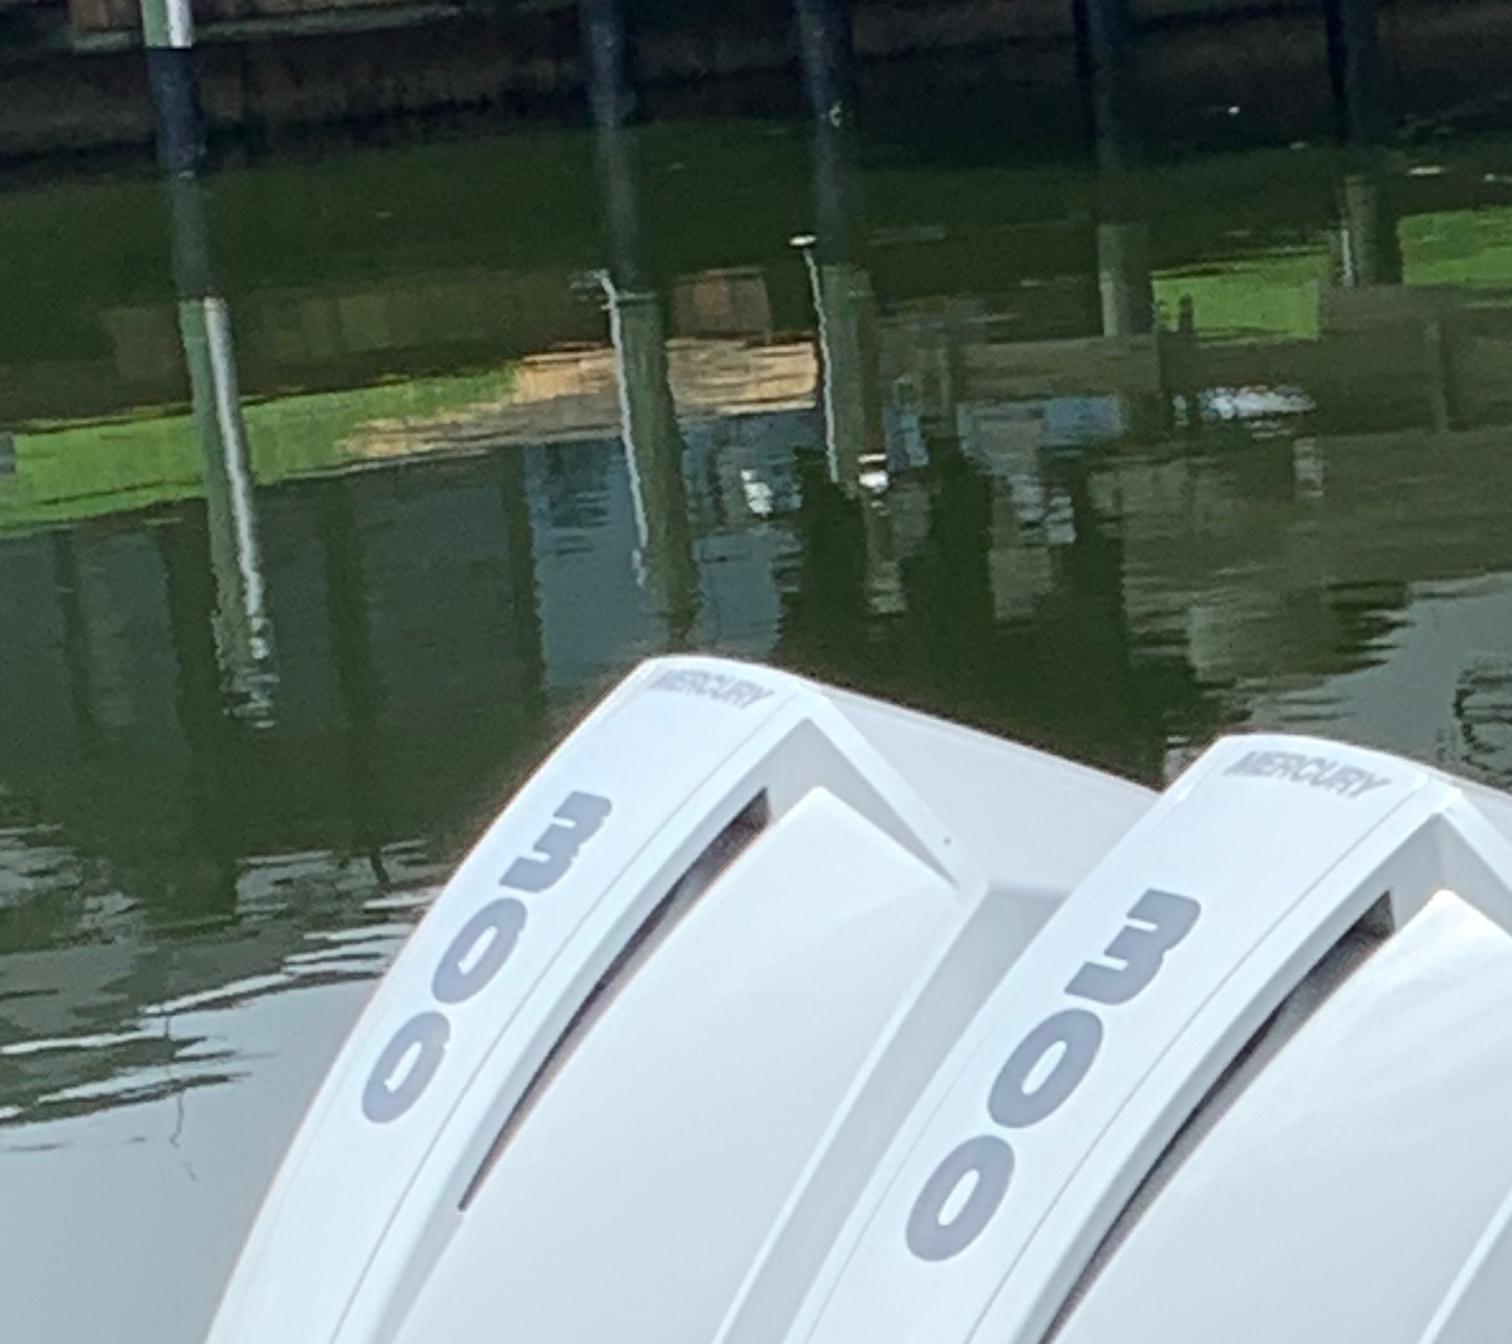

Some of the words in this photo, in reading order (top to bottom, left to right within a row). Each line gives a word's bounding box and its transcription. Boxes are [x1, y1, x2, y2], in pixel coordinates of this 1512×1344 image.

[648, 669, 775, 710] MERCURY
[1222, 751, 1392, 797] MERCURY
[361, 790, 613, 1124] 300
[904, 887, 1202, 1262] 300
